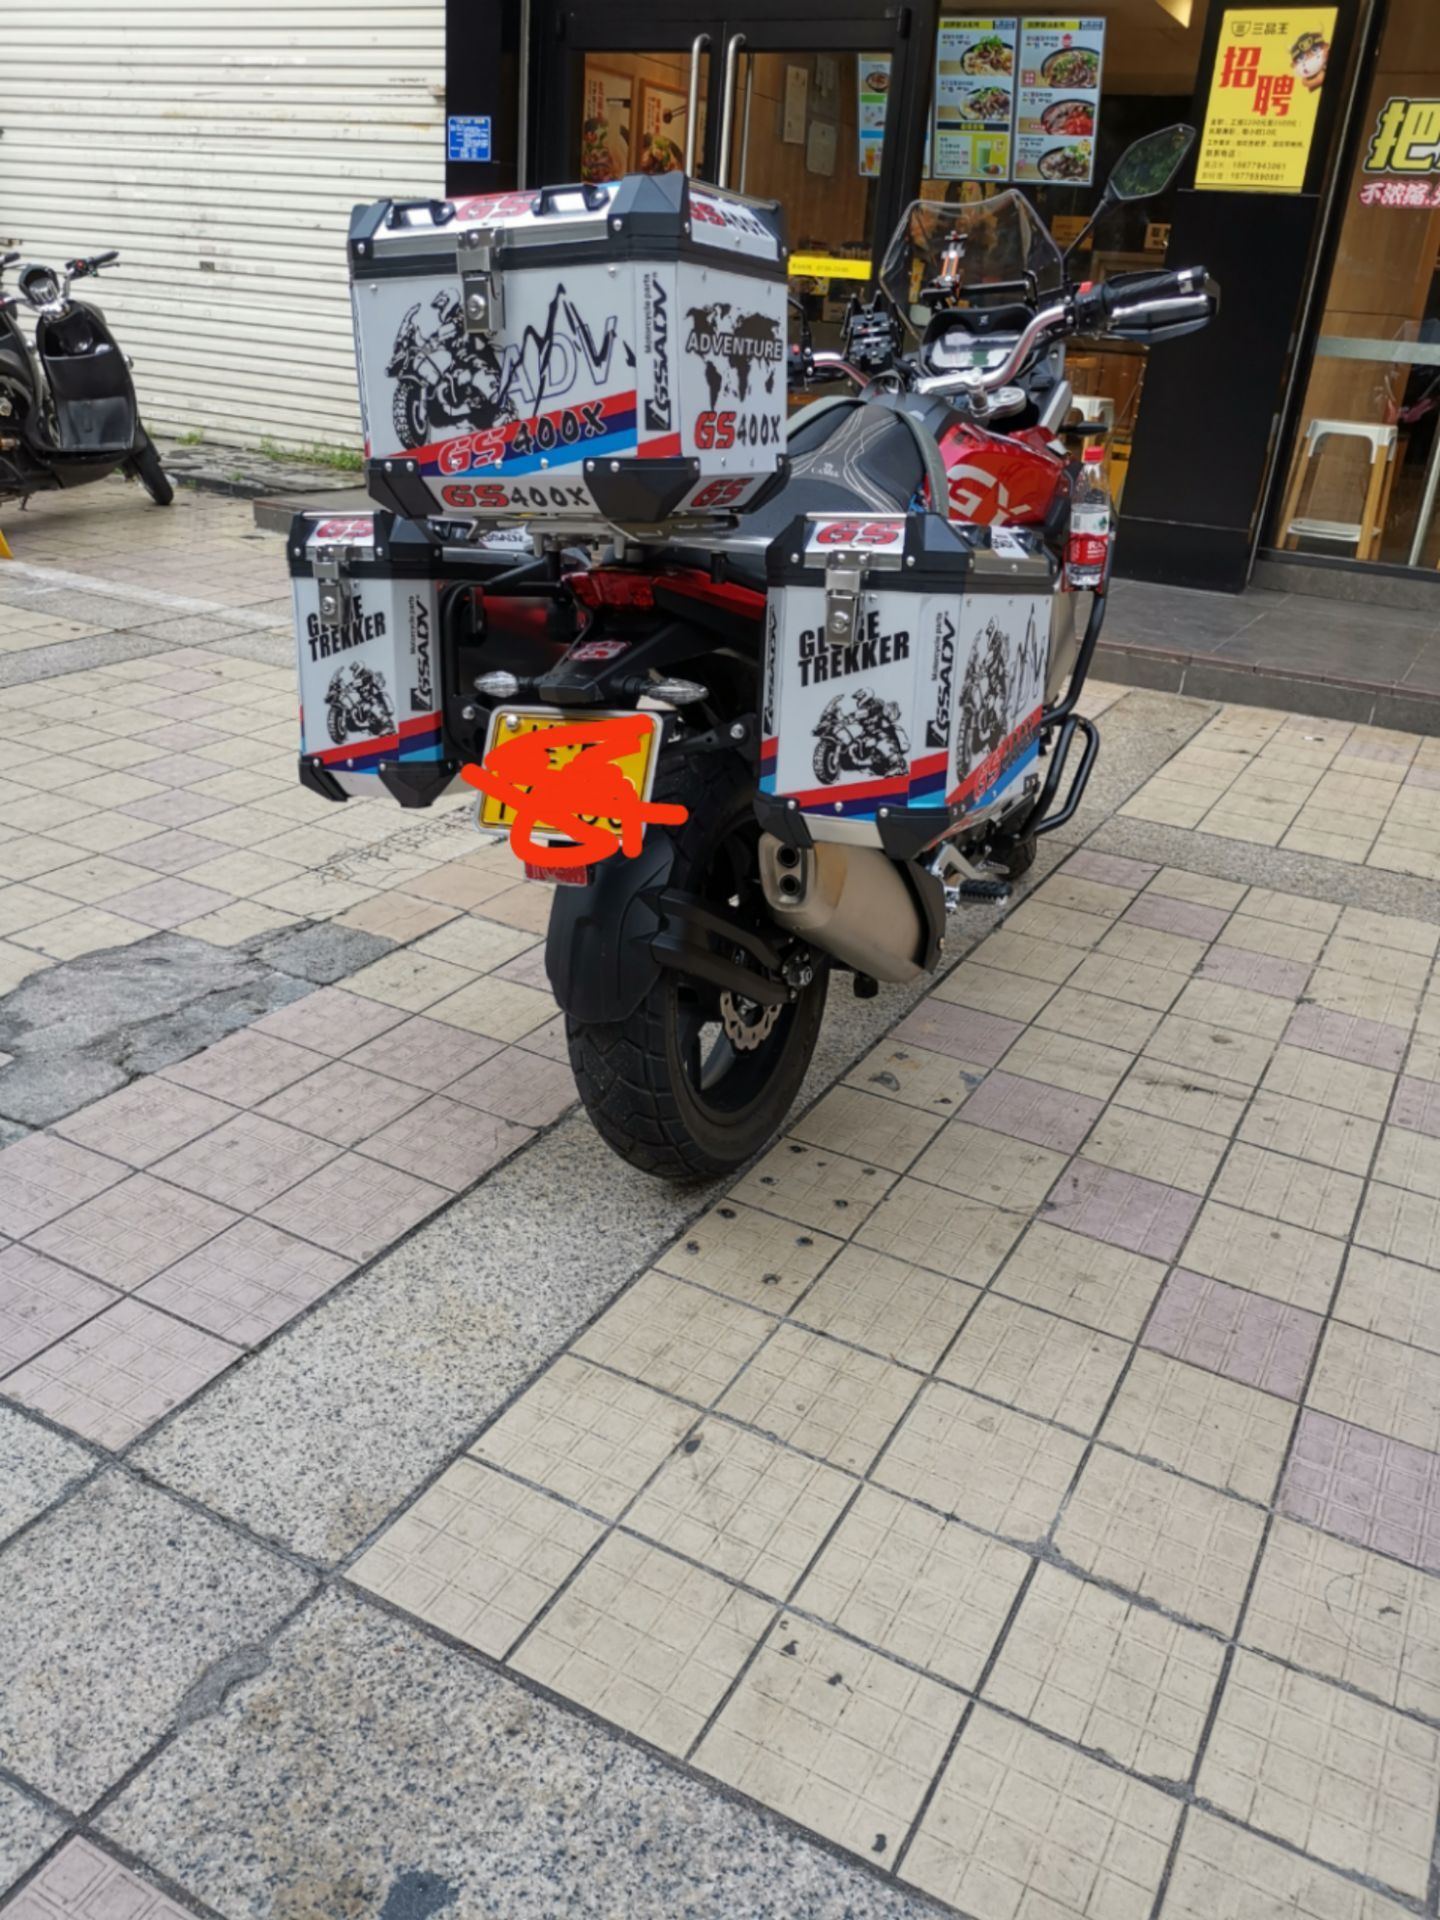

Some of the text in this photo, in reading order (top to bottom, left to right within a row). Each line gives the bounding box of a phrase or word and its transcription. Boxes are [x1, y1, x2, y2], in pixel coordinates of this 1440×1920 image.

[1251, 21, 1289, 36] 三品王
[1219, 46, 1295, 117] 招聘
[1362, 97, 1440, 173] 把
[684, 331, 784, 362] ADVENTURE
[692, 477, 755, 508] GS
[314, 518, 375, 540] GS
[815, 521, 902, 546] GS
[308, 611, 386, 663] TREKKER
[799, 610, 881, 659] GLE
[797, 630, 910, 688] TREKKER
